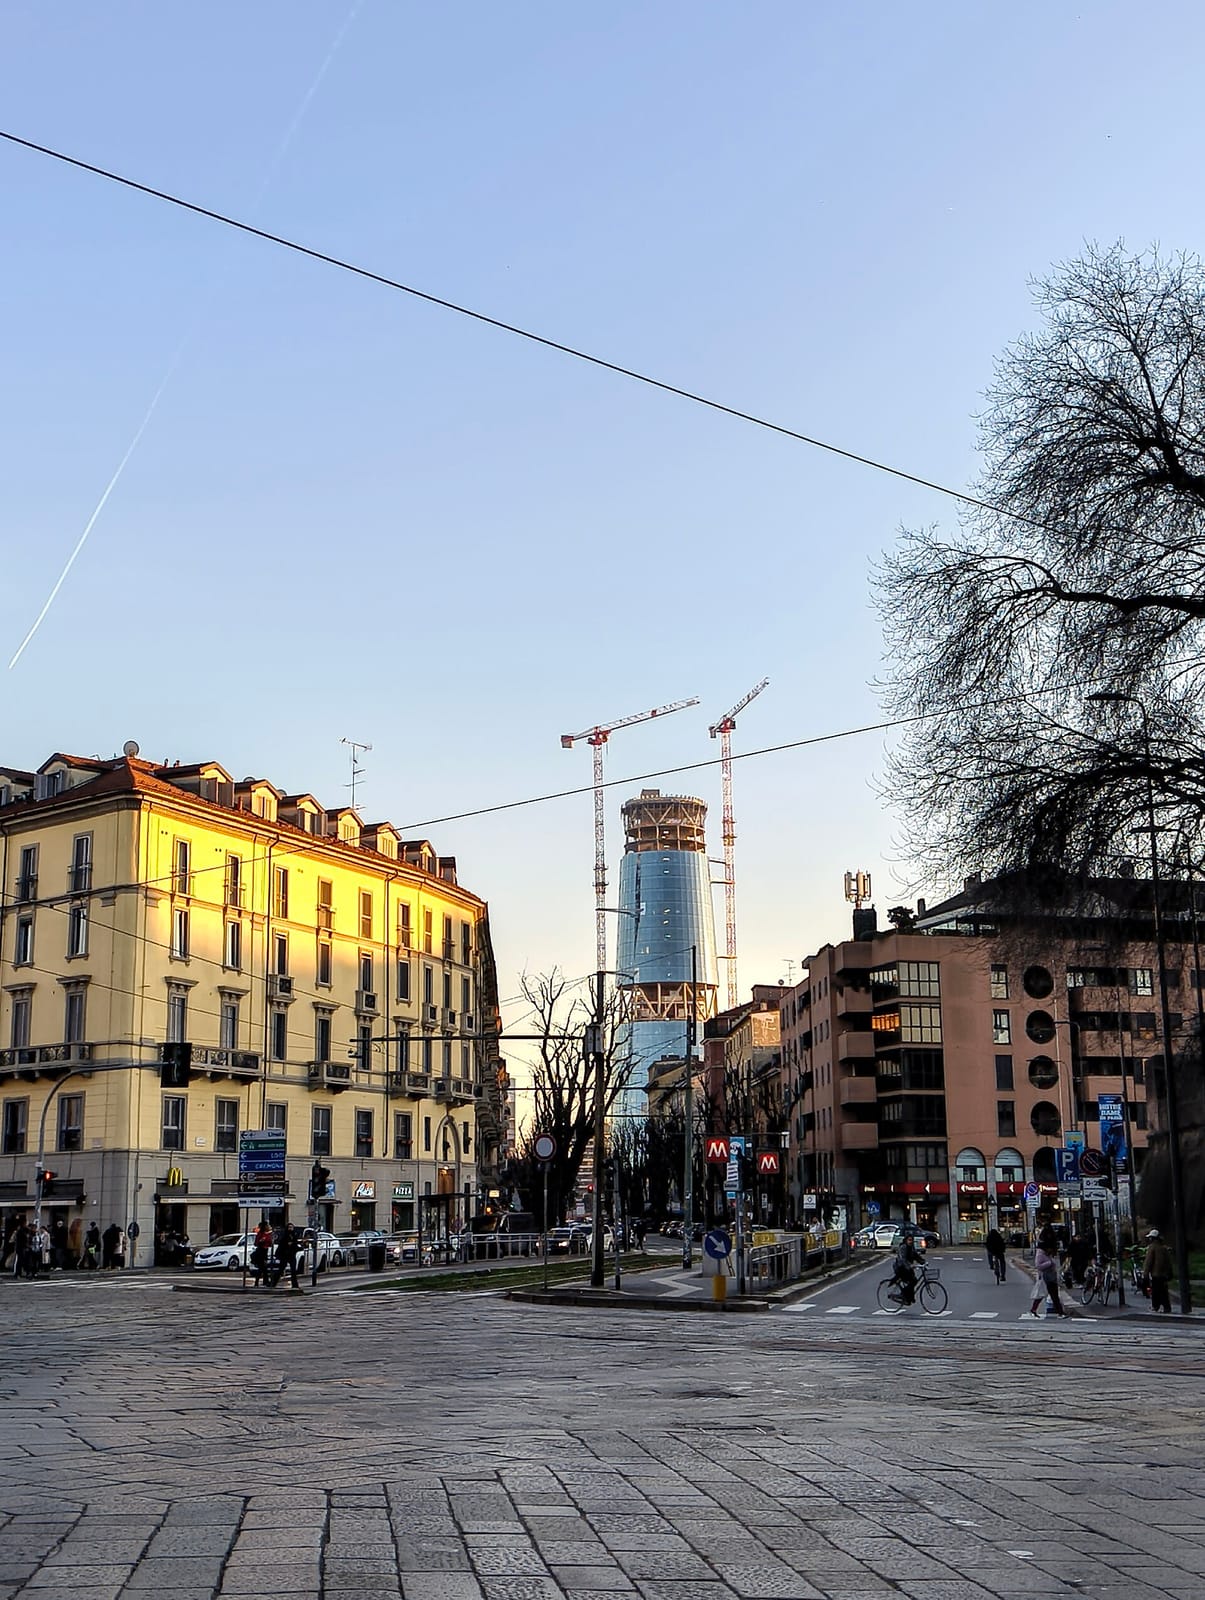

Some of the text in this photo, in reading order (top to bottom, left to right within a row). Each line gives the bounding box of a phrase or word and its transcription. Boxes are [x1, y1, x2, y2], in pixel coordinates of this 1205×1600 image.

[707, 1142, 728, 1158] M
[760, 1156, 777, 1170] M
[1062, 1152, 1074, 1168] P
